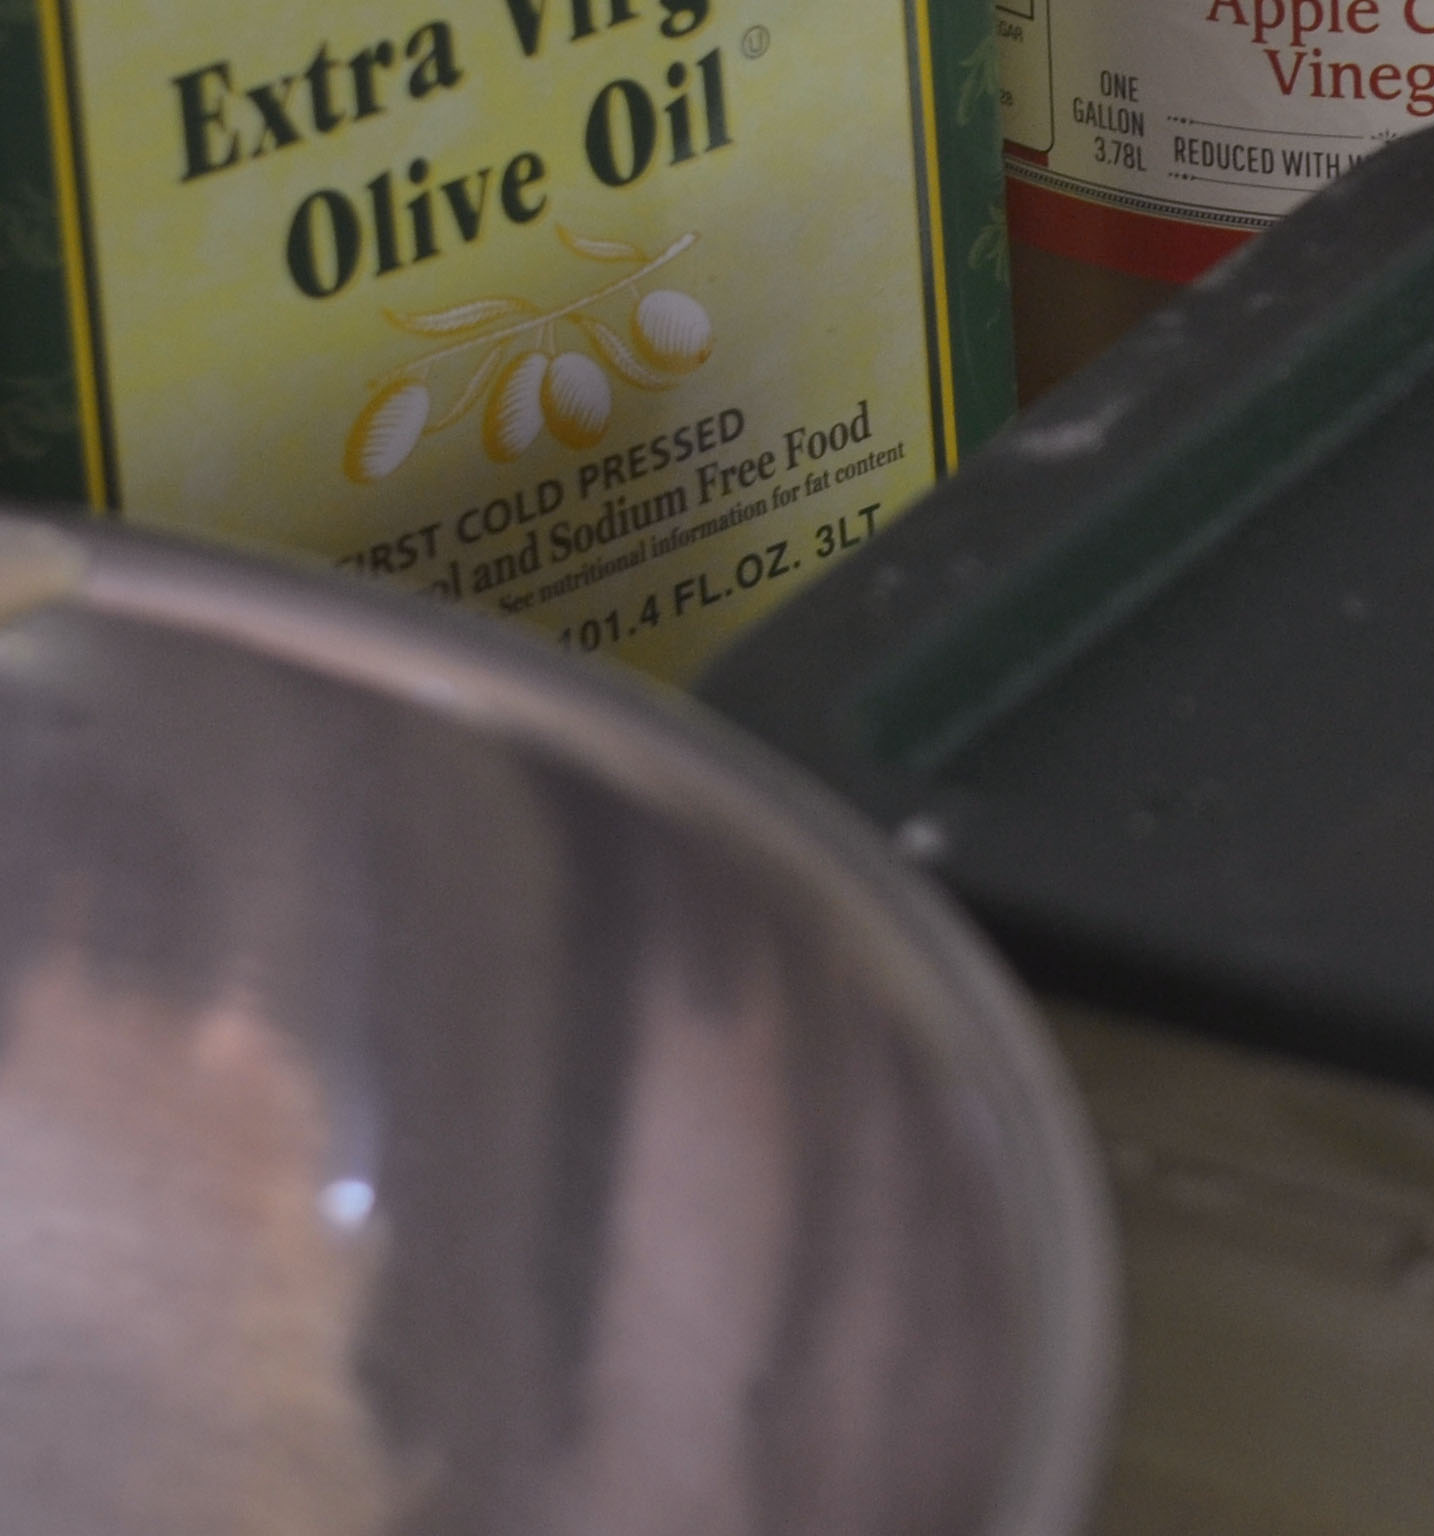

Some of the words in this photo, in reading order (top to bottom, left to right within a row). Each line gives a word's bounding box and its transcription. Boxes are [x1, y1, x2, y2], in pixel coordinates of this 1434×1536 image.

[171, 17, 463, 184] Extra
[1073, 97, 1144, 138] GALLON
[1093, 137, 1147, 172] 3.78L
[1100, 70, 1140, 101] ONE
[287, 151, 548, 300] Olive
[586, 47, 733, 188] Oil
[1175, 137, 1274, 175] REDUCED
[1282, 149, 1340, 179] WITH
[456, 480, 564, 544] COLD
[580, 408, 746, 497] PRESSED
[473, 530, 542, 594] and
[550, 485, 687, 565] Sodium
[695, 445, 777, 507] Free
[784, 398, 873, 471] Food
[499, 590, 544, 613] See
[542, 546, 647, 603] nutritional
[652, 499, 767, 560] information
[772, 480, 801, 512] for
[806, 465, 831, 494] fat
[835, 441, 906, 486] content
[561, 594, 660, 652] 101.4
[672, 541, 801, 616] FL.OZ.
[816, 503, 881, 559] 3LT
